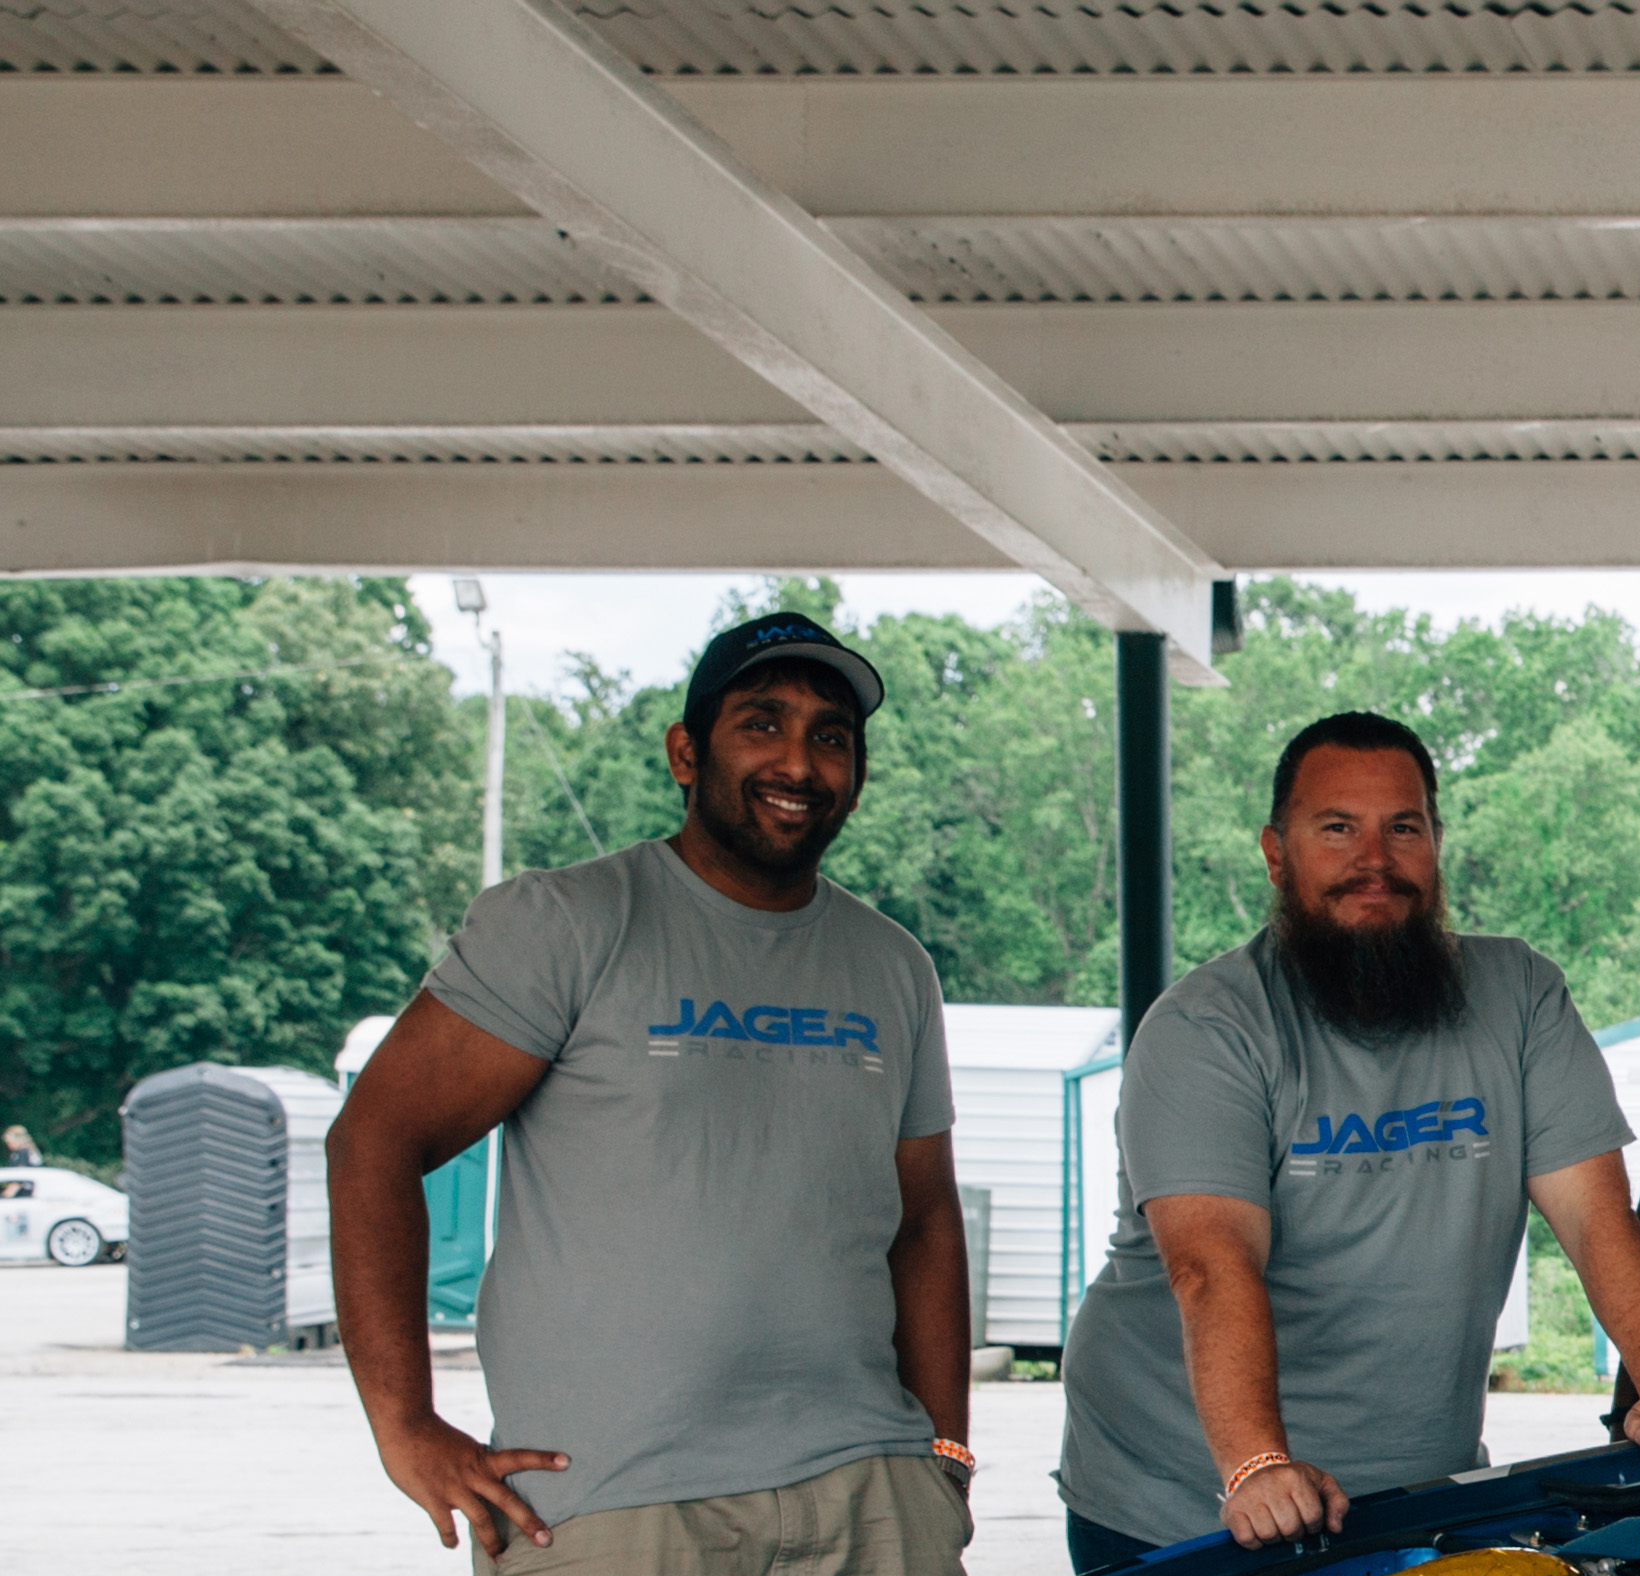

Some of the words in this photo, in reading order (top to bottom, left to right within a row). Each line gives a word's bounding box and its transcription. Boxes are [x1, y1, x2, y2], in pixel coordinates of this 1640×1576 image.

[648, 998, 881, 1053] JAGER
[687, 1041, 859, 1067] RACING
[1291, 1097, 1489, 1154] JAGER
[1323, 1144, 1467, 1175] RACING
